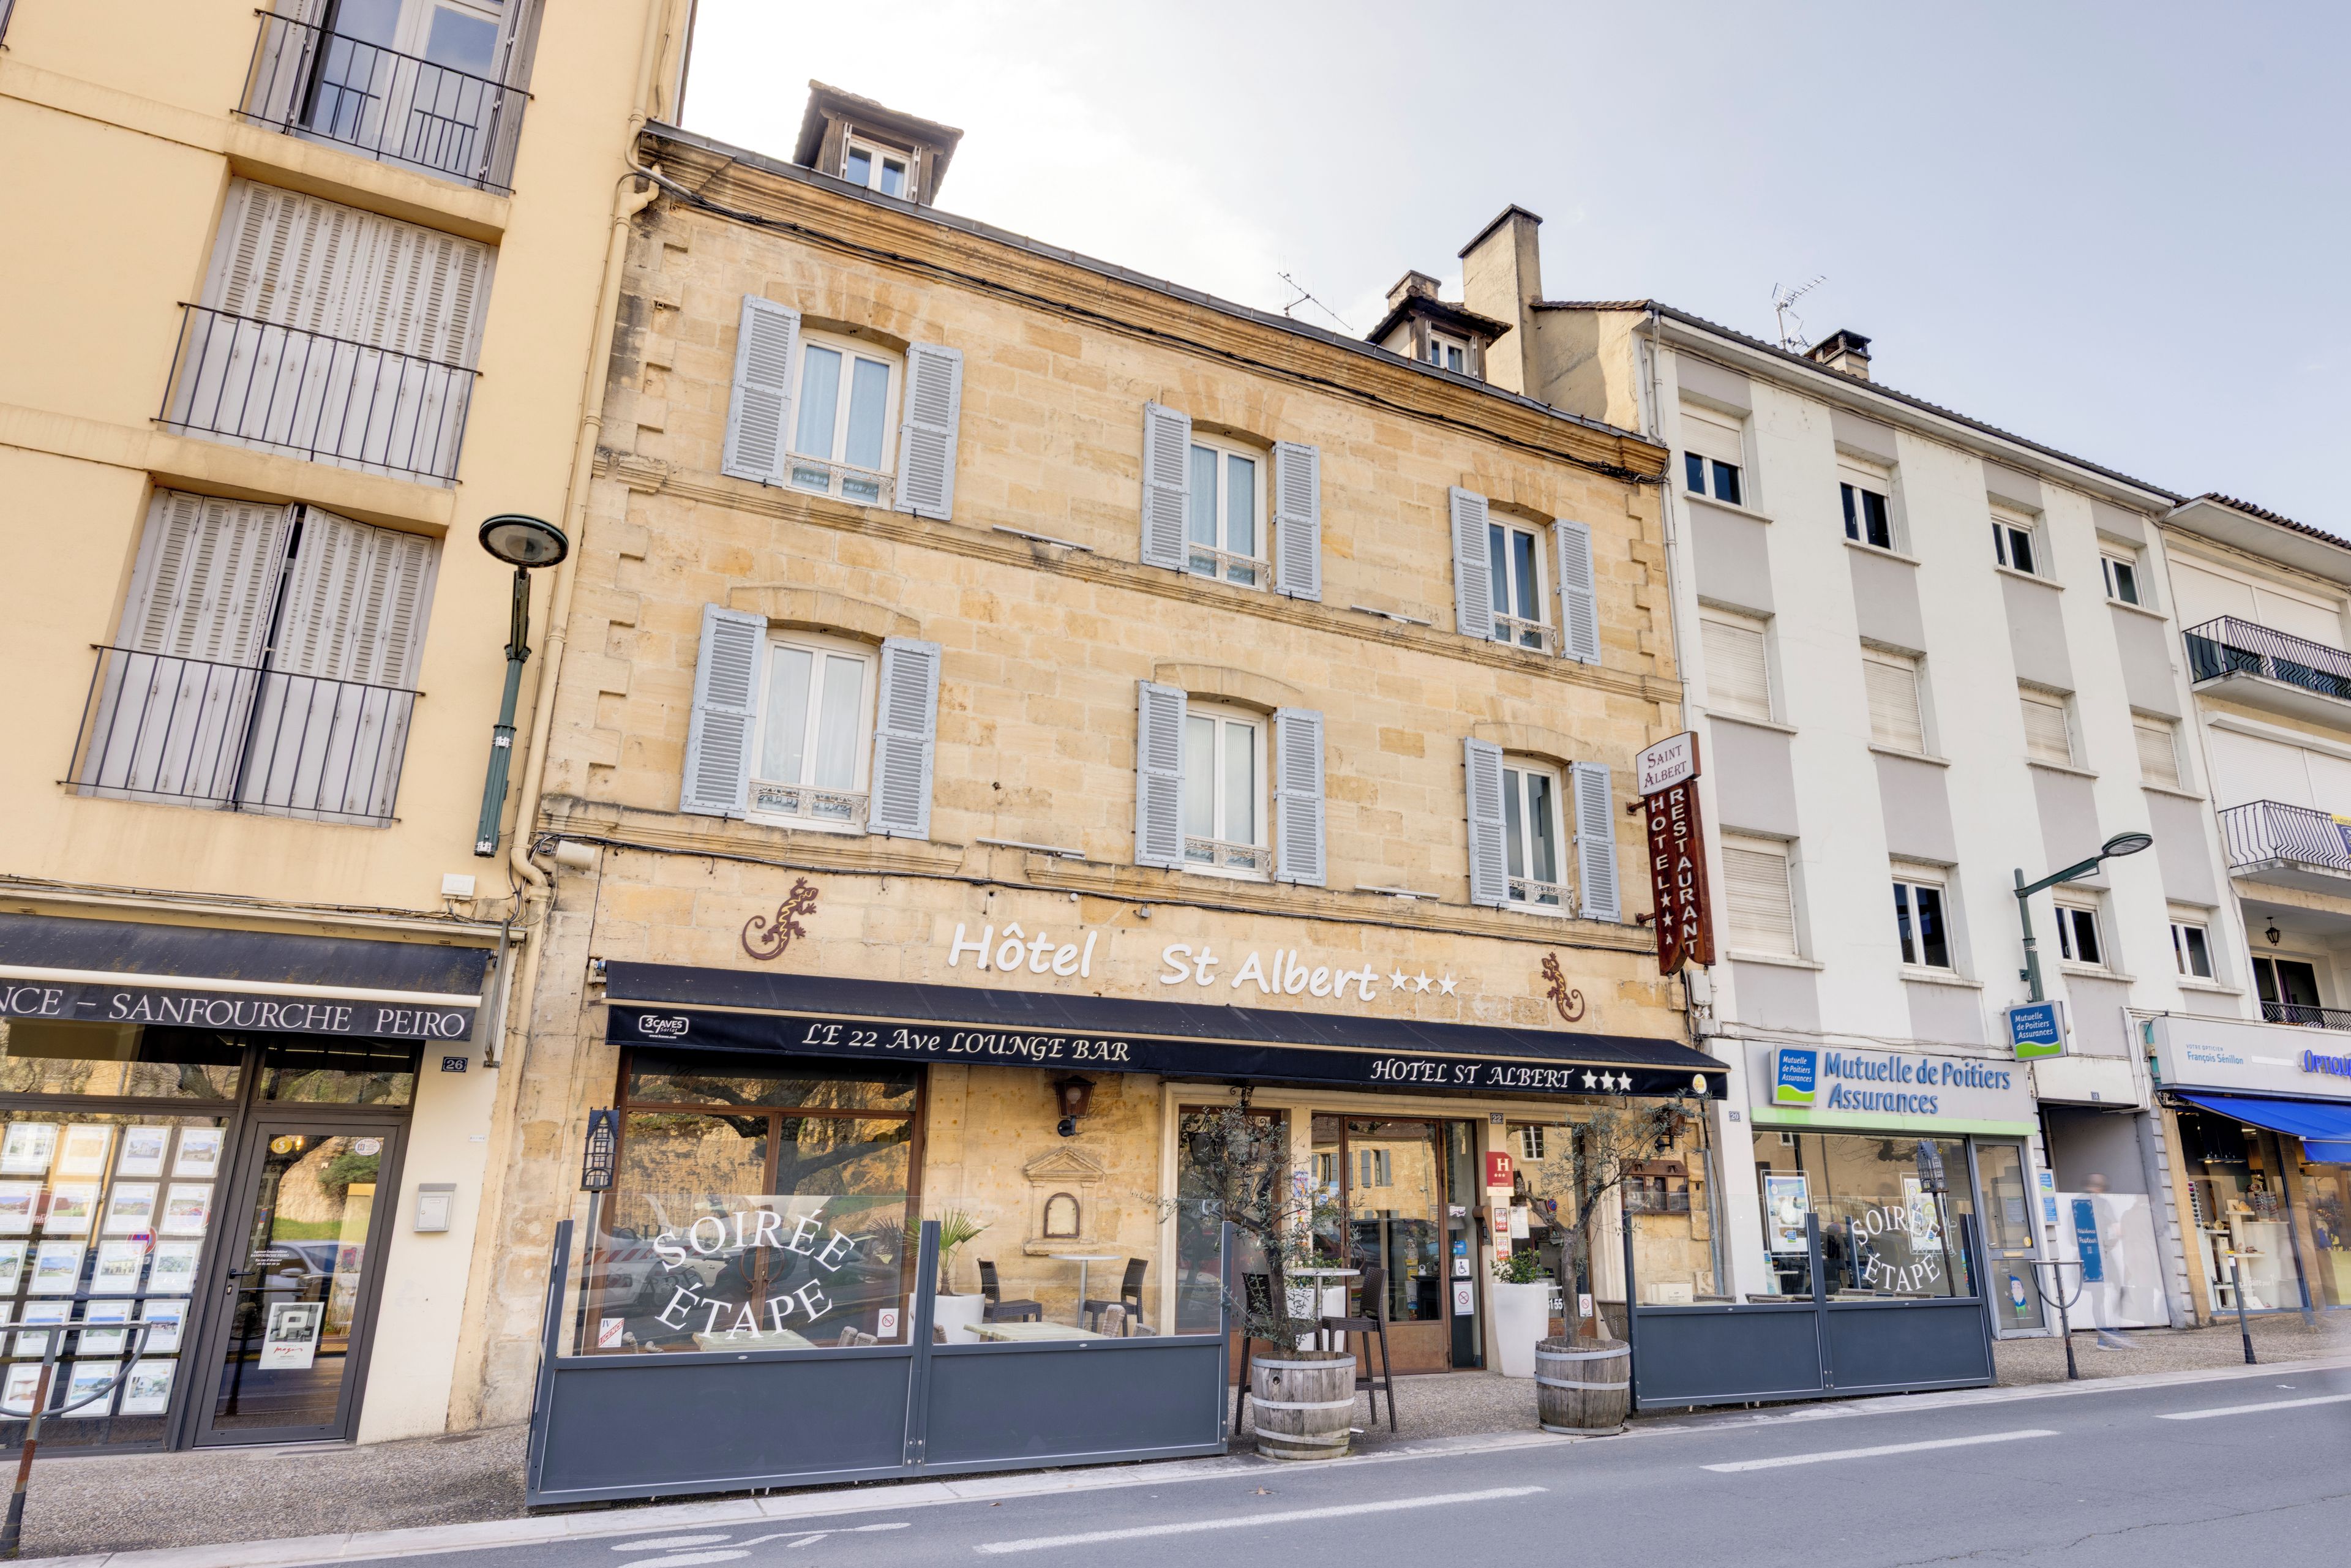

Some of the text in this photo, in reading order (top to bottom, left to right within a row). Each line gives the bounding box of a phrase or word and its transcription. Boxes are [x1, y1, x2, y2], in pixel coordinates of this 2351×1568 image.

[1648, 745, 1682, 769] SAINT
[1644, 761, 1687, 789] ALBERT
[1651, 797, 1669, 890] HOTEL
[1670, 788, 1698, 955] RESTAURANT
[948, 922, 1098, 978] Hôtel
[1160, 943, 1379, 1001] St Albert
[109, 993, 351, 1032] SANFOURCHE
[374, 1008, 465, 1037] PEIRO
[2015, 1012, 2042, 1022] Mutuelle
[2025, 1021, 2050, 1030] Poitiers
[802, 1024, 1131, 1062] LE 22 Ave LOUNGE BAR
[2018, 1029, 2053, 1038] Assurances
[446, 1059, 463, 1071] 26
[1370, 1059, 1575, 1088] HOTEL ST ALBERT
[1824, 1052, 2011, 1090] Mutuelle de Poitiers
[2187, 1051, 2243, 1065] François Sénillon
[1782, 1074, 1812, 1082] Assurances
[1828, 1083, 1938, 1114] Assurances
[1497, 1158, 1510, 1171] H
[653, 1209, 856, 1273] SOIRÉE
[1851, 1205, 1940, 1247] SOIRÉE
[1862, 1253, 1940, 1291] ÉTAPE
[654, 1278, 833, 1340] ÉTAPE
